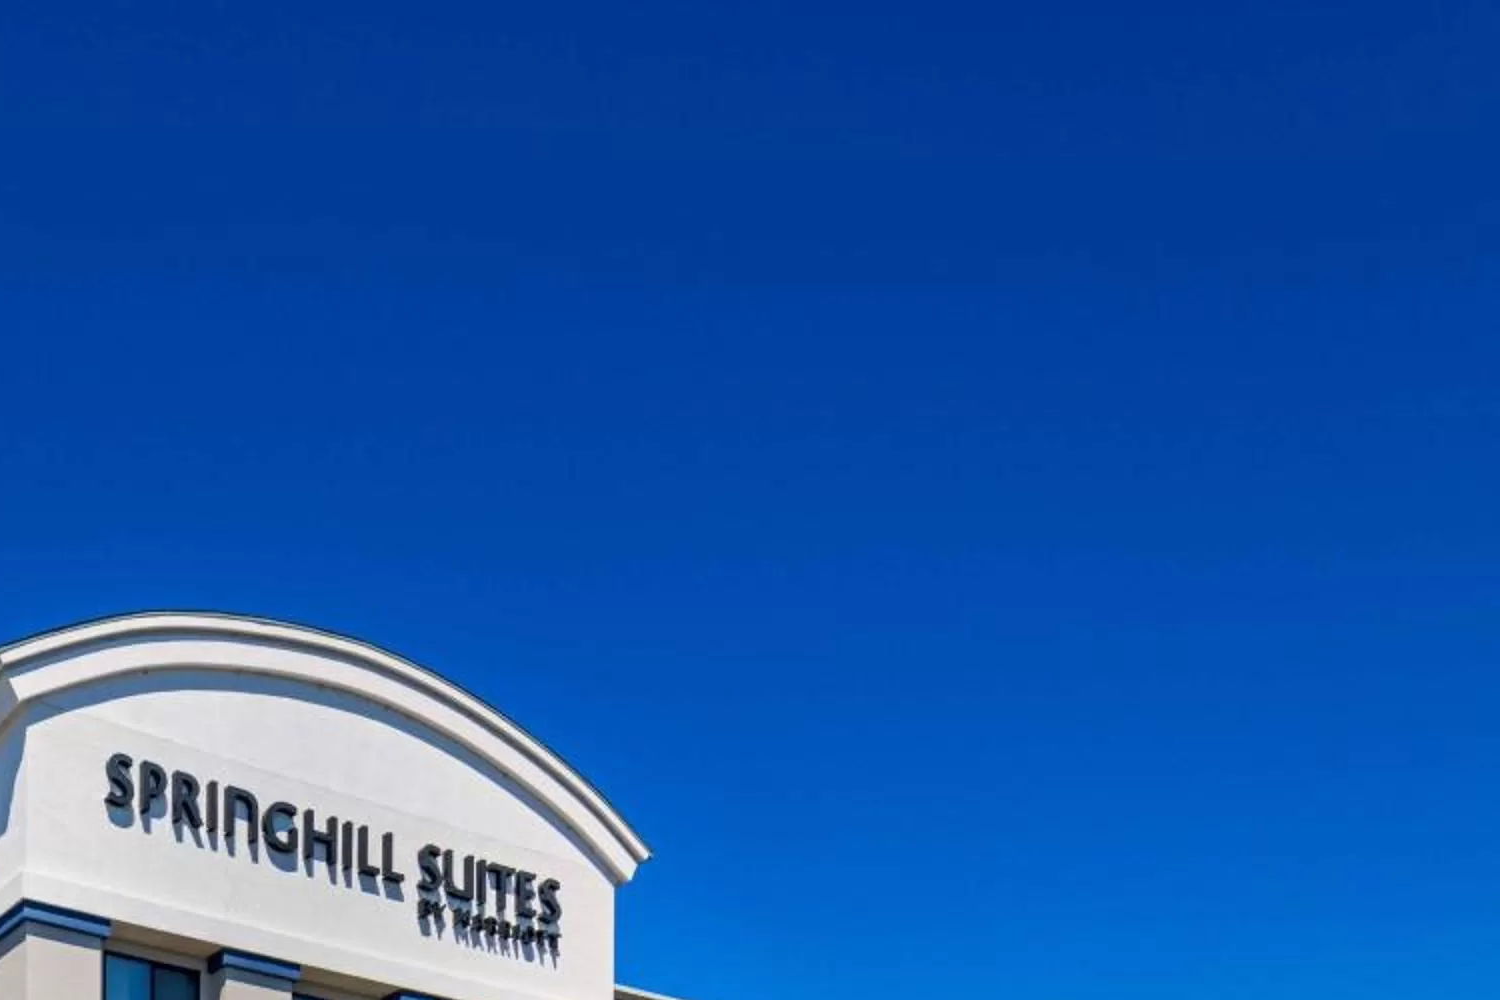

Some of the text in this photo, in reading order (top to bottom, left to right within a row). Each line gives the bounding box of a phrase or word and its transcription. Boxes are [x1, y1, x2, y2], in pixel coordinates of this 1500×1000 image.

[104, 753, 562, 924] SPRINGHILL SUITES
[418, 899, 446, 919] BY
